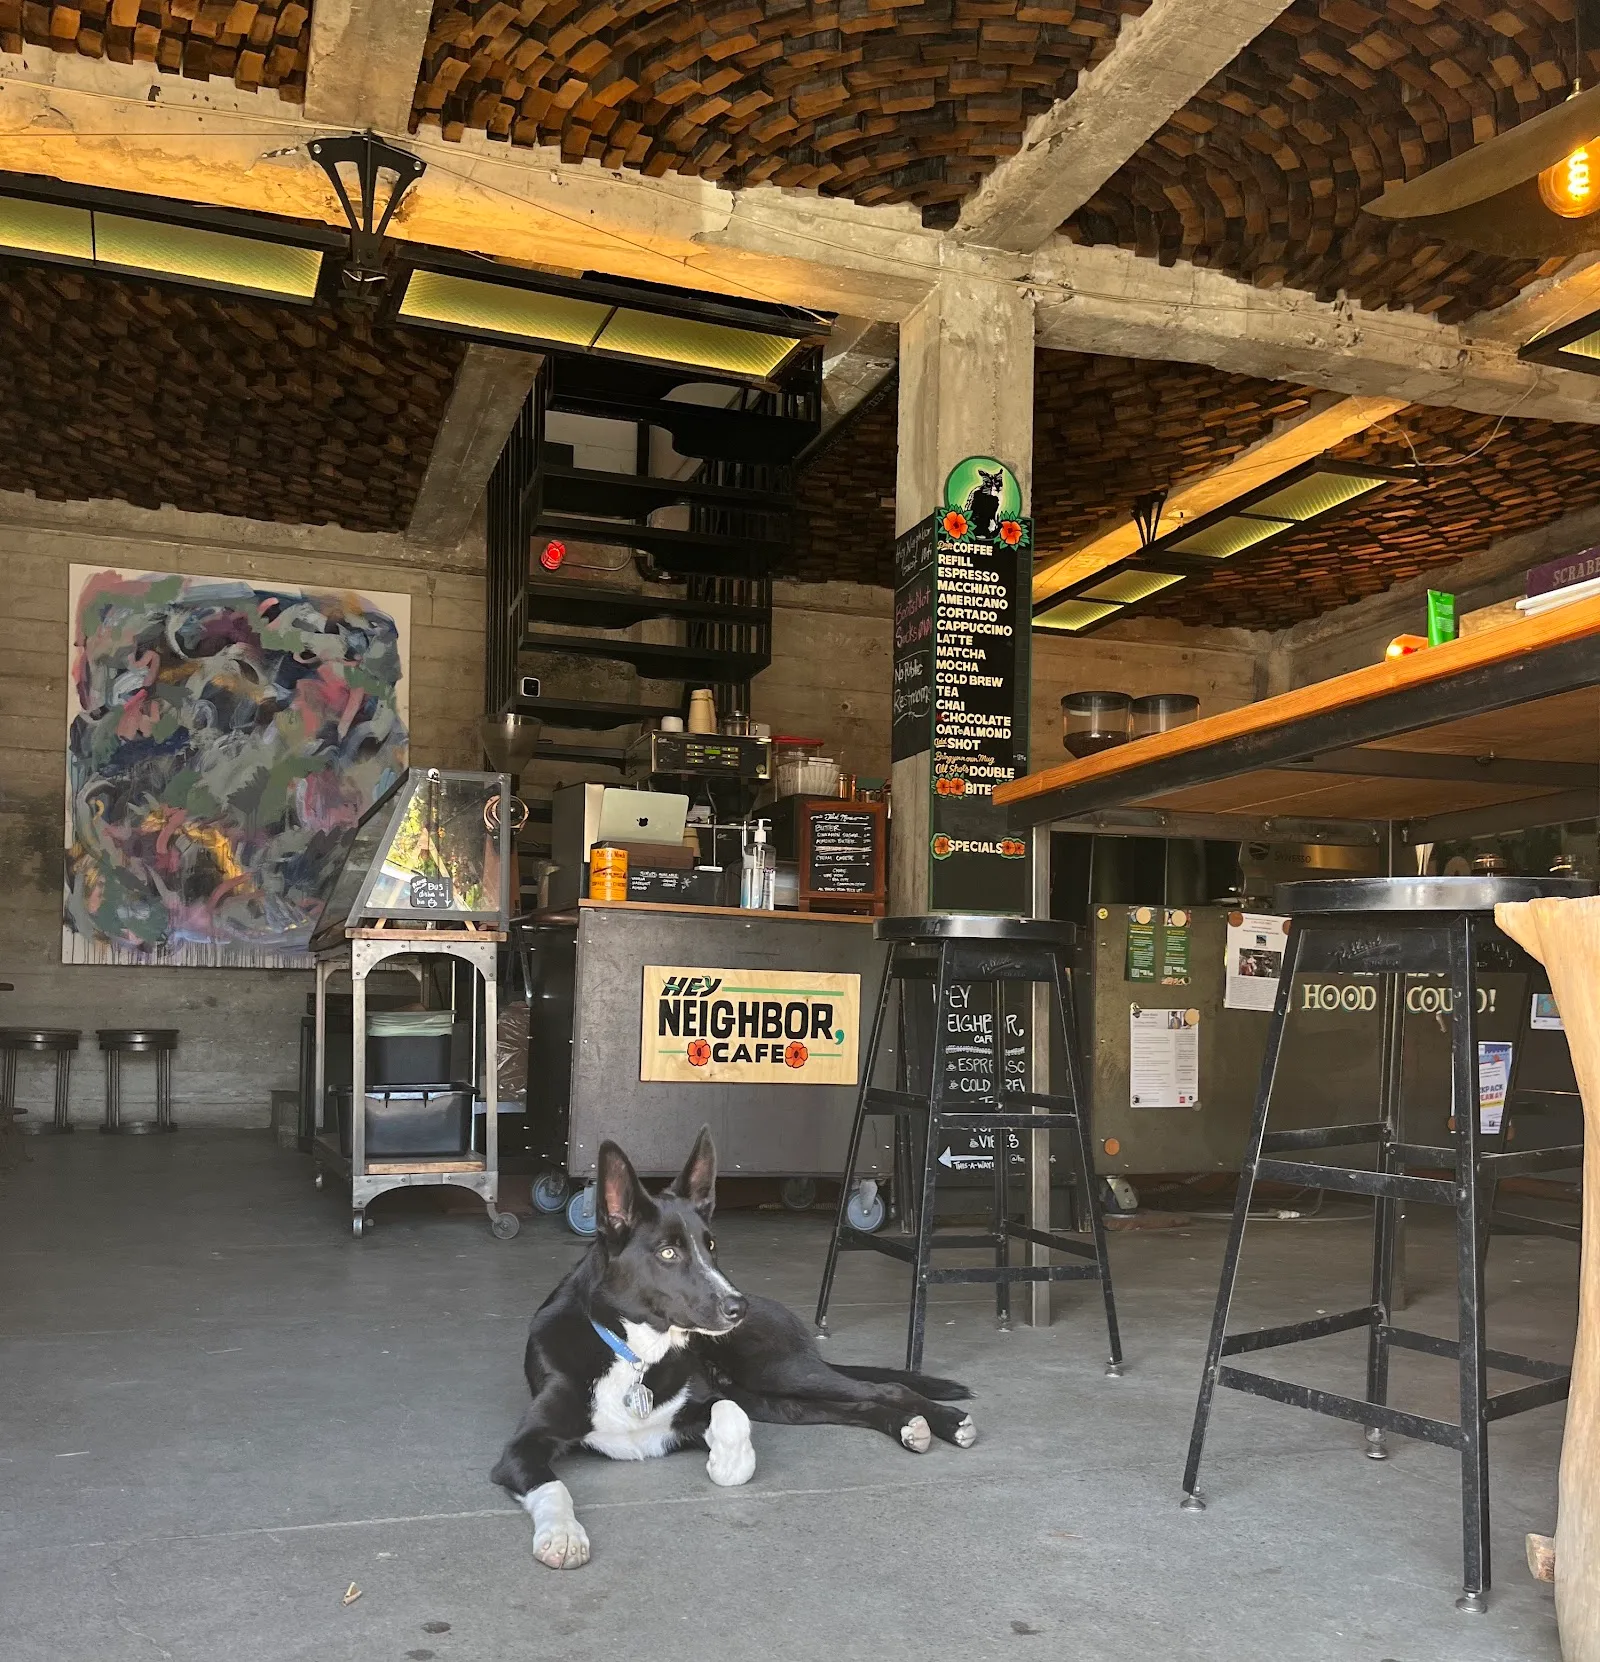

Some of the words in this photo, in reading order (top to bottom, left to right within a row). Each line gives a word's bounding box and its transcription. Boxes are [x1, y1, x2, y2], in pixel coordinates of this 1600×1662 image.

[953, 543, 993, 556] COFFEE
[938, 554, 973, 567] REFILL
[938, 567, 1000, 583] ESPRESSO
[937, 580, 1007, 597] MACCHIATO
[938, 593, 1009, 610] AMERICANO
[937, 606, 998, 622] CORTADO
[937, 620, 1013, 637] CAPPUCCINO
[937, 633, 974, 646] LATTE
[937, 646, 987, 660] MATCHA
[936, 659, 979, 672] MOCHA
[936, 672, 968, 685] COLD
[969, 675, 1004, 688] BREW
[936, 685, 959, 698] TEA
[936, 699, 965, 711] CHAI
[941, 711, 1012, 727] CHOCOLATE
[936, 724, 960, 736] OAT
[963, 726, 1012, 740] ALMOND
[948, 738, 981, 750] SHOT
[969, 766, 1015, 778] DOUBLE
[948, 839, 1004, 855] SPECIALS
[661, 976, 722, 998] HEY
[1301, 984, 1377, 1011] HOOD
[658, 999, 845, 1046] NEIGHBOR,
[713, 1042, 784, 1064] CAFE
[960, 1078, 991, 1092] COLD
[1480, 1084, 1503, 1094] KPACK
